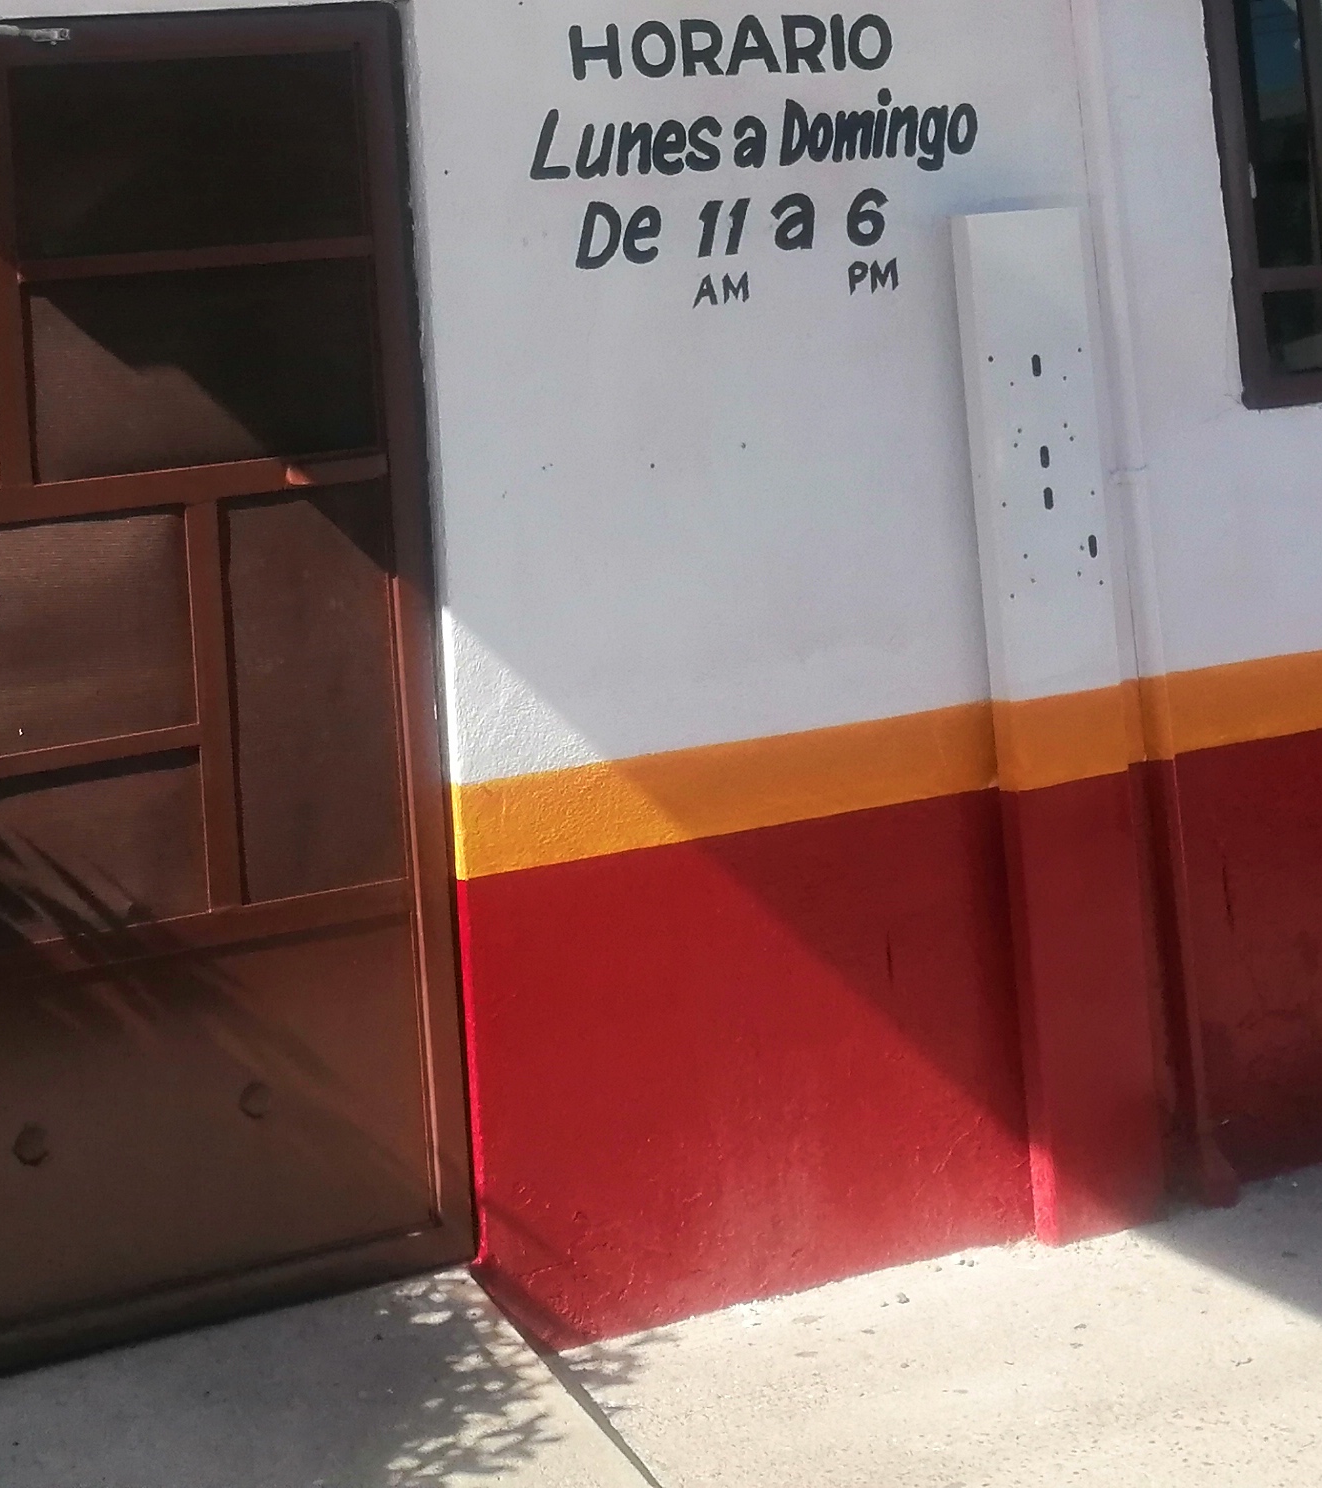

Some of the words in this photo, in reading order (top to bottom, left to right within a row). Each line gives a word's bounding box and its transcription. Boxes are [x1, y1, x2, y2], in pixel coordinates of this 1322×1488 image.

[568, 13, 892, 80] HORARIO
[529, 109, 722, 180] Lunes
[734, 116, 767, 168] a
[780, 88, 977, 171] Domingo
[575, 201, 661, 270] De
[698, 198, 750, 258] 11
[771, 193, 815, 250] a
[846, 188, 889, 247] 6
[693, 271, 750, 308] AM
[848, 258, 899, 295] PM
